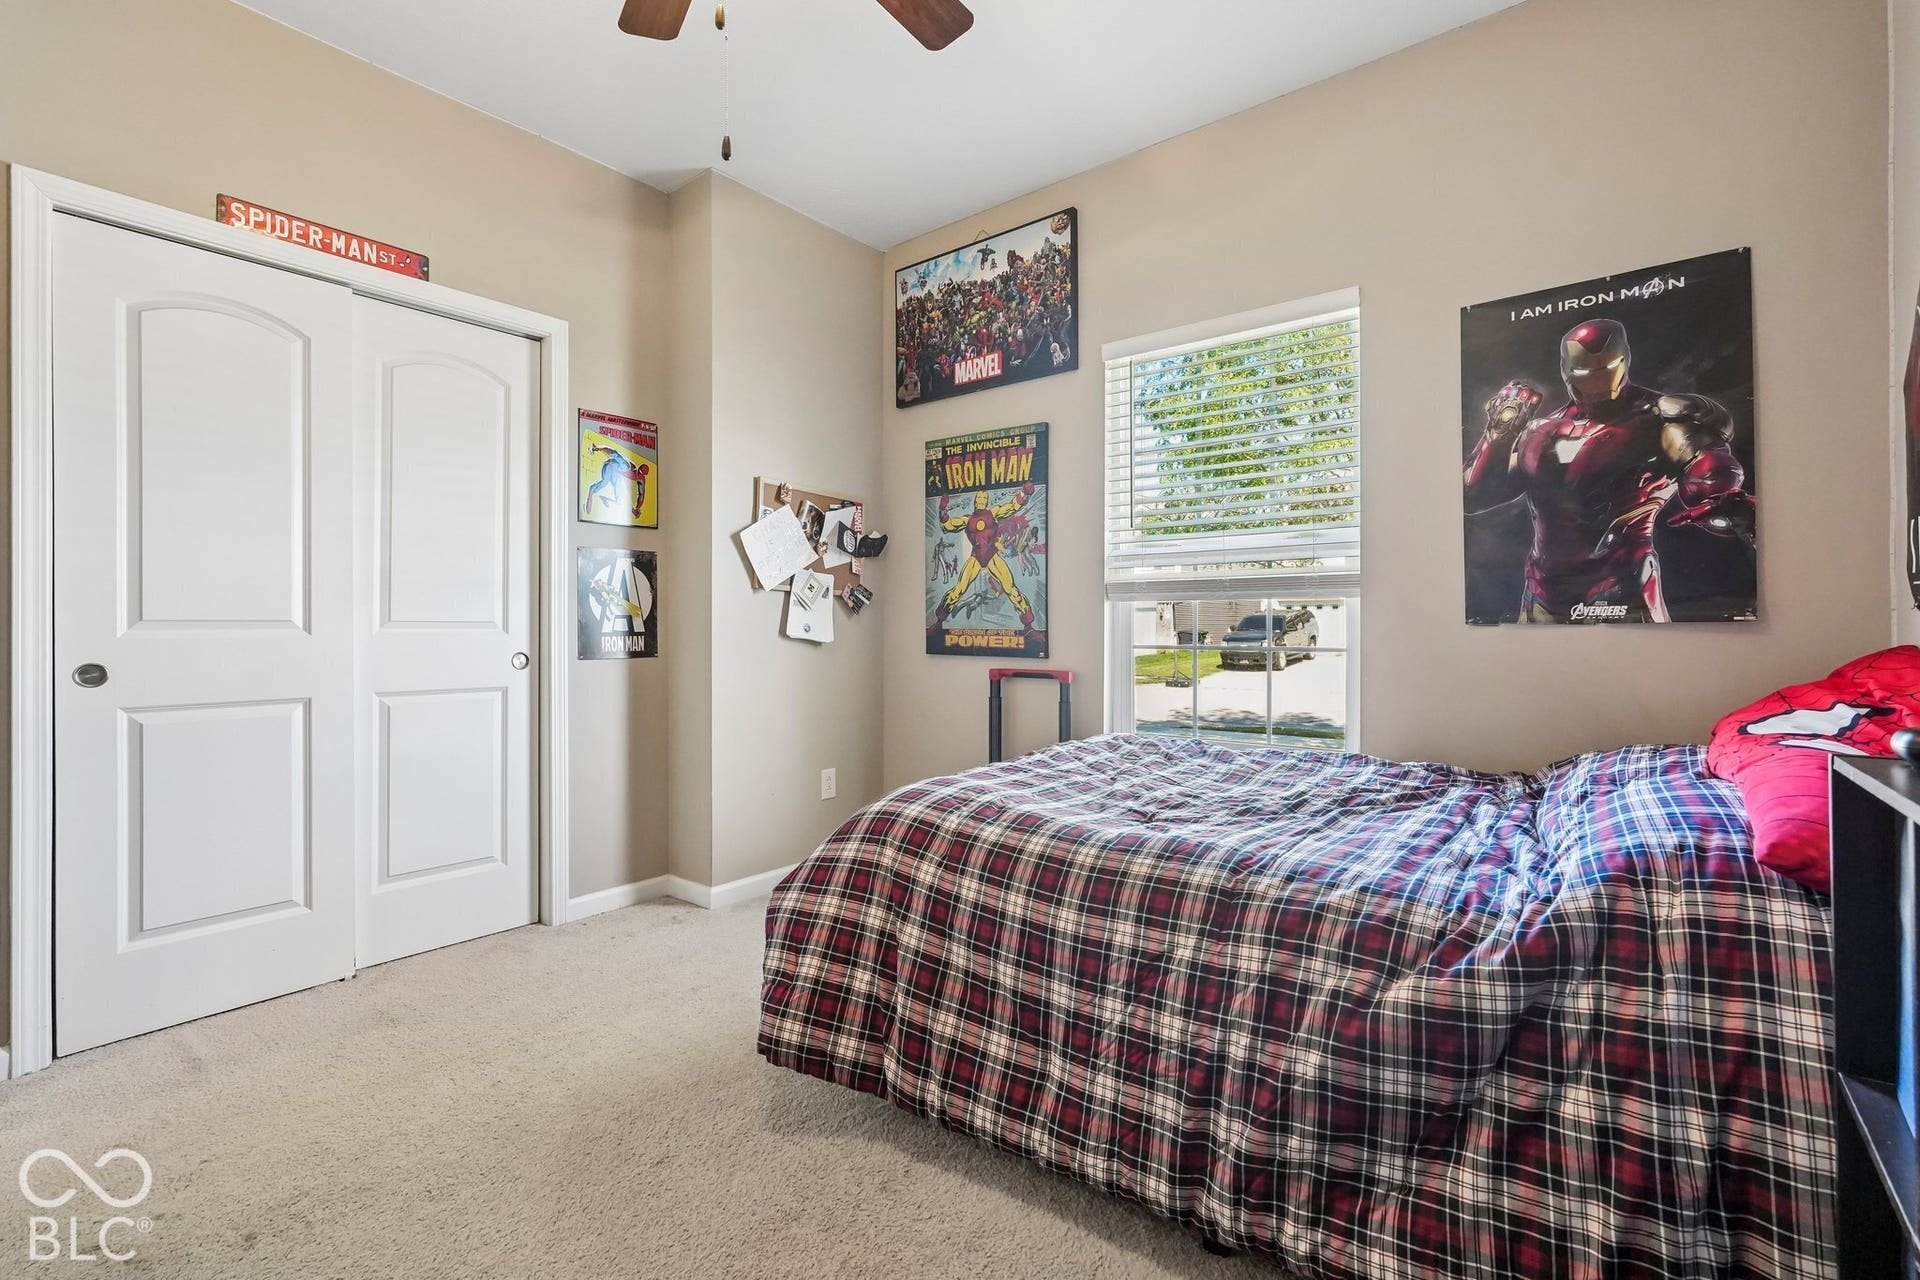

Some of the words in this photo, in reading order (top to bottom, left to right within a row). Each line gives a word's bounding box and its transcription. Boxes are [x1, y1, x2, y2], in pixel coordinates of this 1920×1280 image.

[230, 202, 377, 264] SPIDER-MAN
[1511, 311, 1515, 321] I
[1520, 304, 1552, 320] AM
[1558, 291, 1613, 312] IRON
[954, 354, 1001, 384] MARVEL
[599, 426, 656, 450] SPIDER-MAN
[945, 445, 963, 456] THE
[967, 436, 1021, 452] INVINCIBLE
[946, 436, 973, 446] MARVEL
[976, 431, 1005, 441] COMICS
[1009, 426, 1035, 435] GROUP
[945, 457, 986, 490] IRON
[991, 451, 1034, 485] MAN
[1570, 602, 1628, 620] AVENGERS
[601, 635, 623, 652] IRON
[625, 635, 645, 652] MAN
[945, 634, 1024, 649] POWER!
